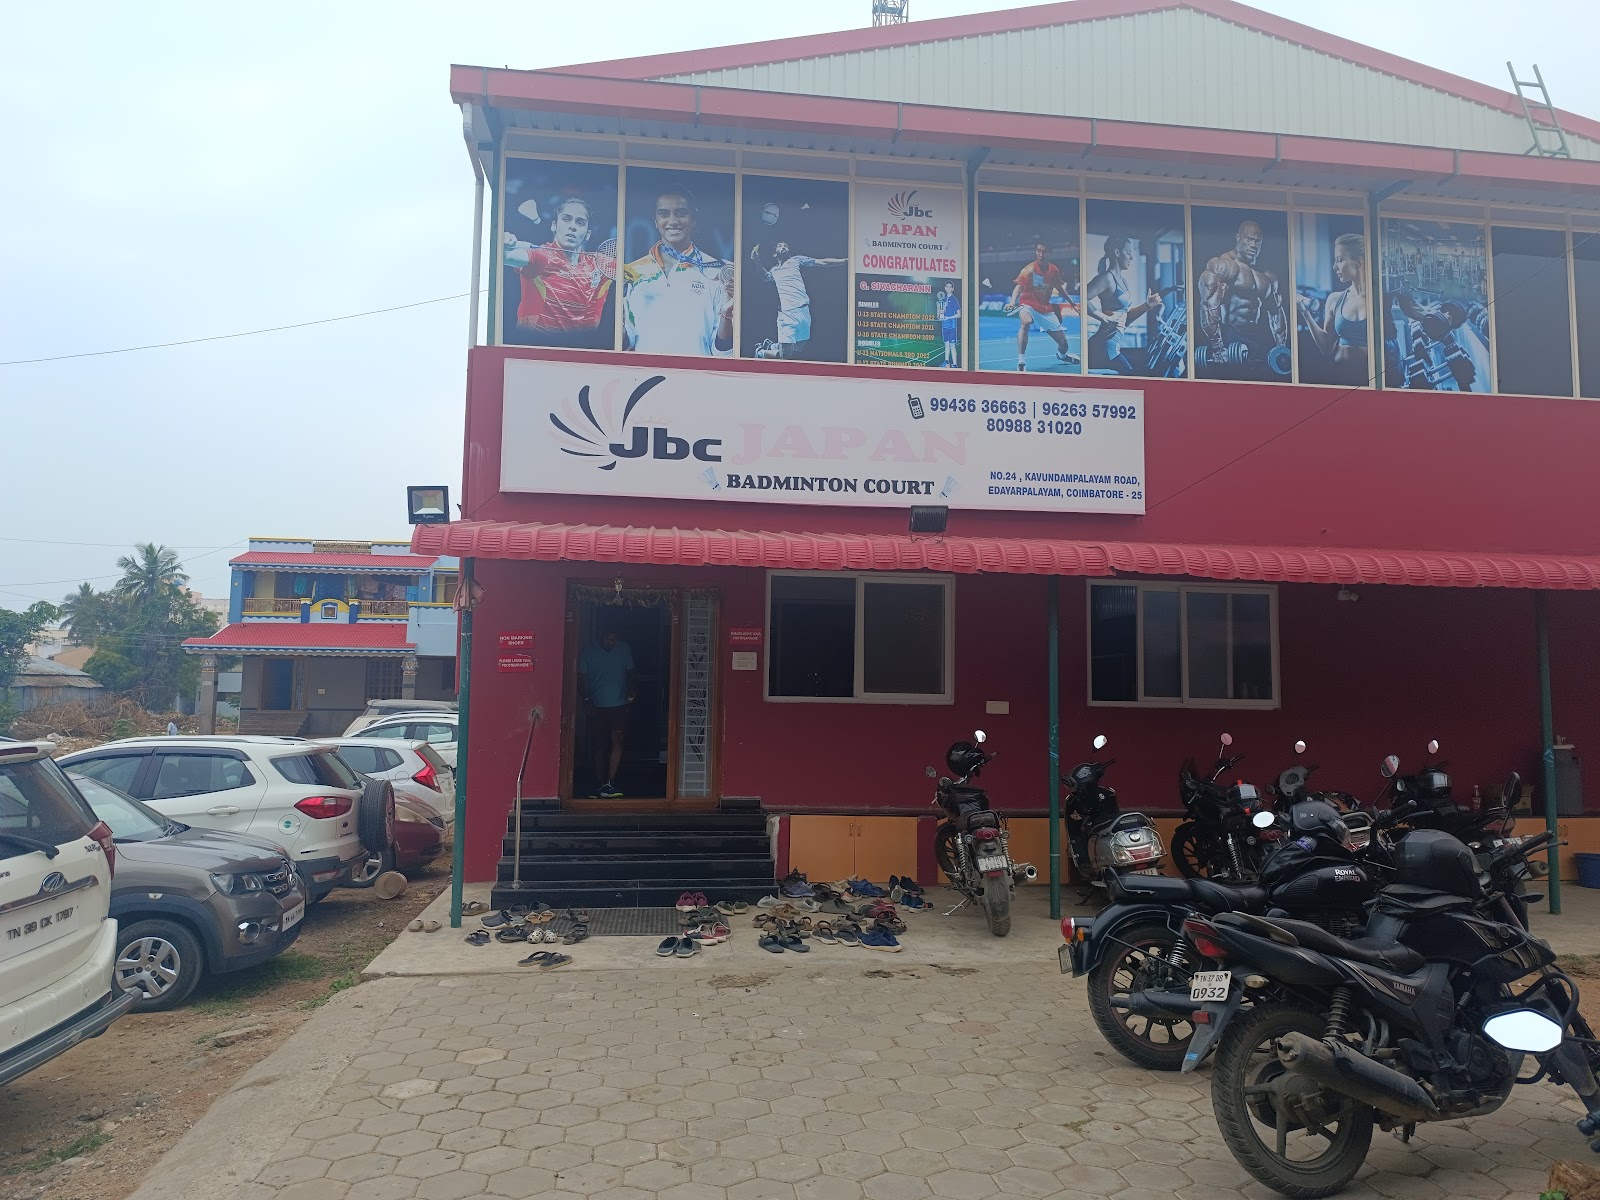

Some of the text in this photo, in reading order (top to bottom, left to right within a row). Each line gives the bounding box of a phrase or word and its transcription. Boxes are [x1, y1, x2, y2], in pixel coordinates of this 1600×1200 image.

[903, 206, 932, 218] Jbc
[880, 223, 937, 237] JAPAN
[872, 241, 917, 249] BADMINTON
[863, 254, 956, 272] CONGRATULATES
[930, 398, 976, 412] 99436
[981, 400, 1026, 415] 36663
[1042, 402, 1087, 417] 96263
[1092, 405, 1136, 419] 57992
[986, 418, 1082, 435] 80988 31020
[608, 426, 722, 462] Jbc
[731, 423, 969, 466] JAPAN
[726, 474, 934, 494] BADMINTON COURT
[990, 471, 1016, 481] NO.24
[1024, 472, 1112, 484] KAVUNDAMPALAYAM
[1114, 476, 1140, 486] ROAD,
[989, 486, 1064, 498] EDAYARPALAYAM,
[1066, 488, 1124, 499] COIMBATORE
[1132, 491, 1142, 499] 25
[6, 927, 21, 940] TN
[1193, 988, 1225, 998] 0932
